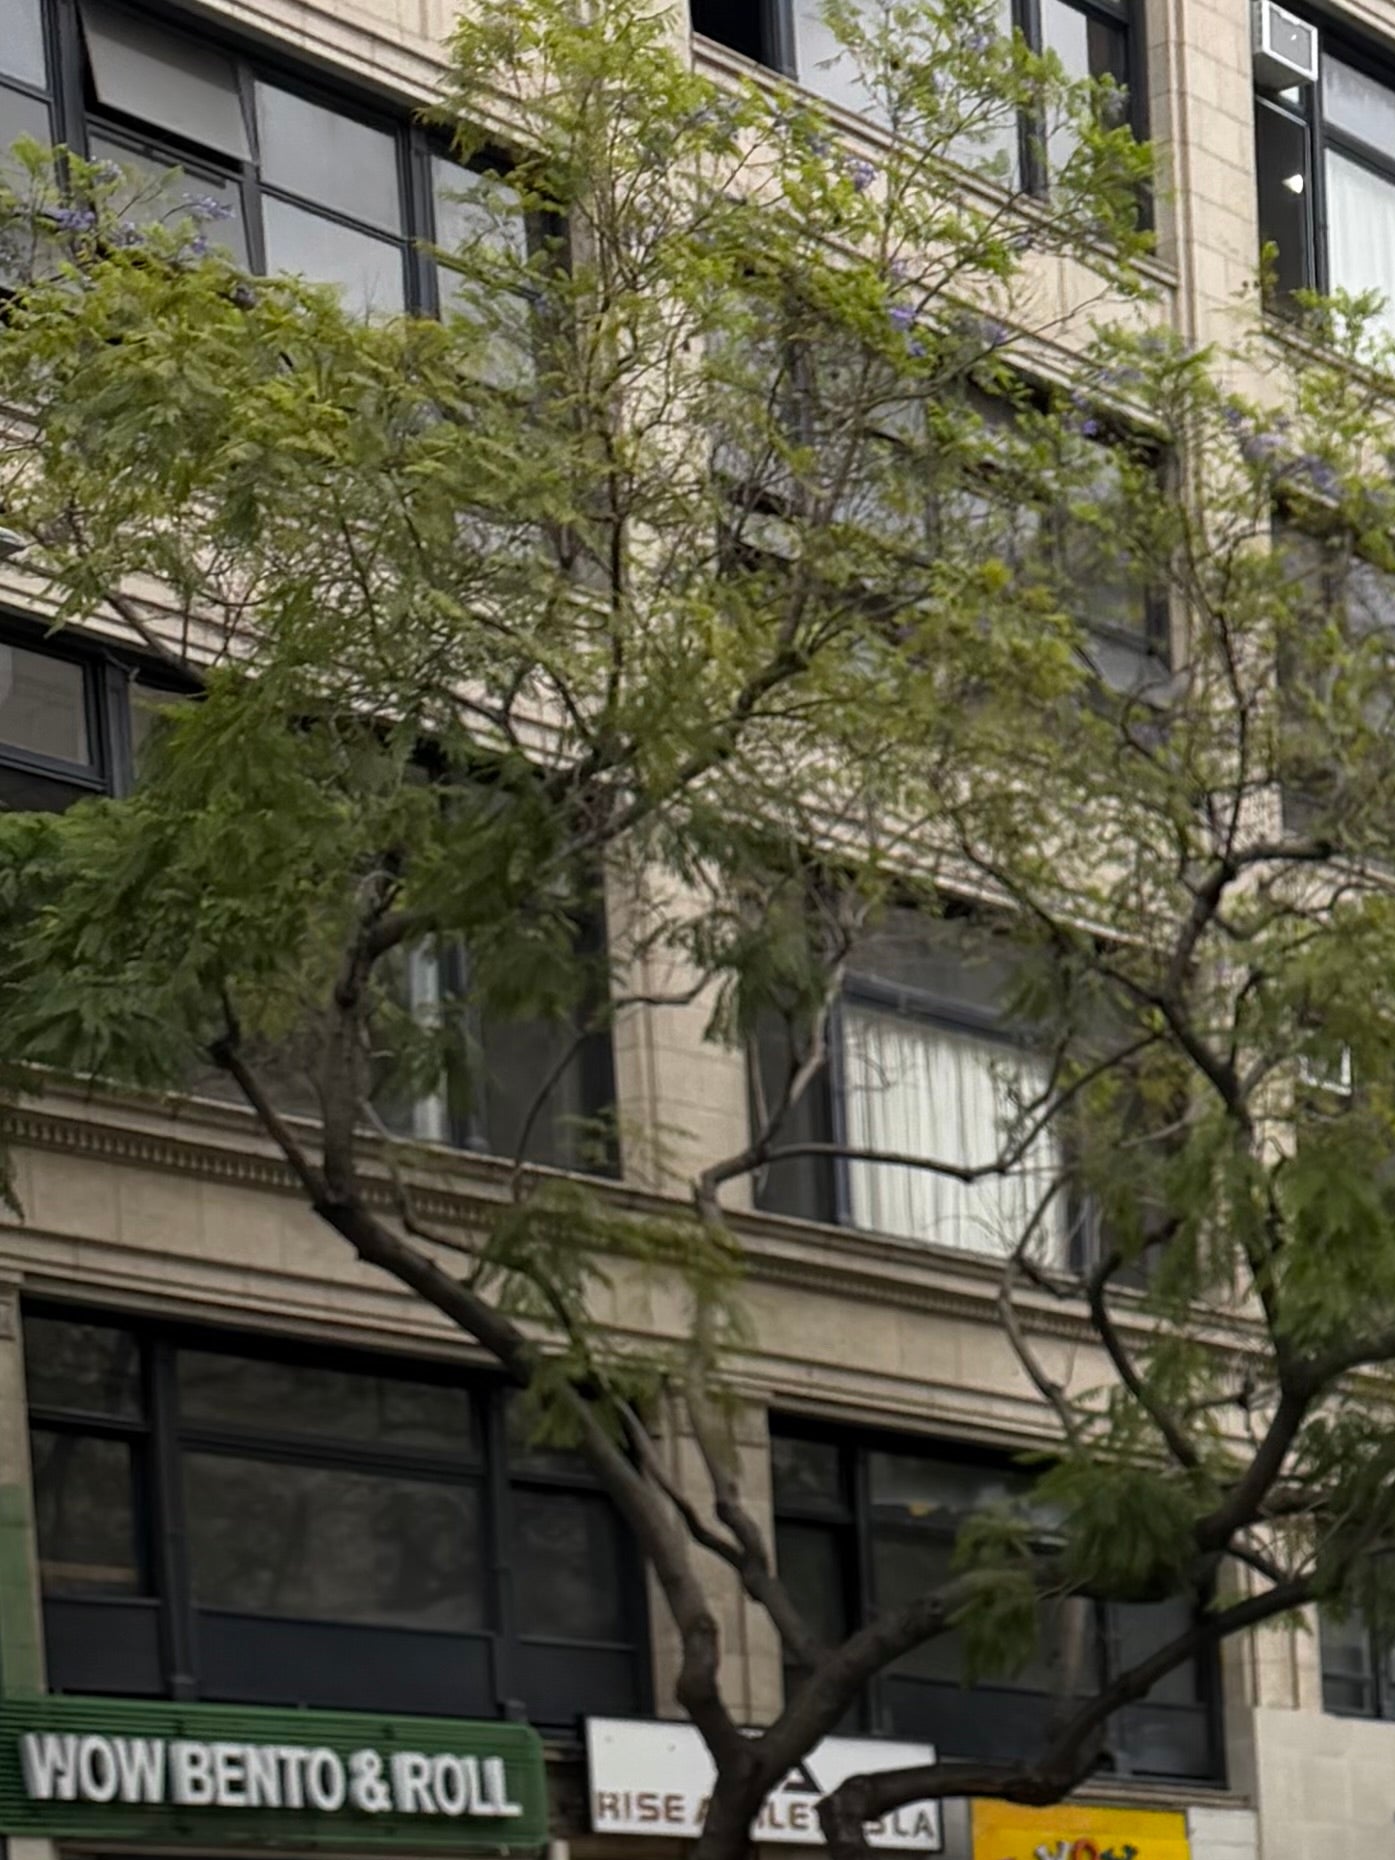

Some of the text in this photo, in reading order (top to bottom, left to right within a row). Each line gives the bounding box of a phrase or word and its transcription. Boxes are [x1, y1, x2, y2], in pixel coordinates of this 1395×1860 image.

[20, 1732, 523, 1817] WOW BENTO & ROLL
[597, 1791, 686, 1823] RISE
